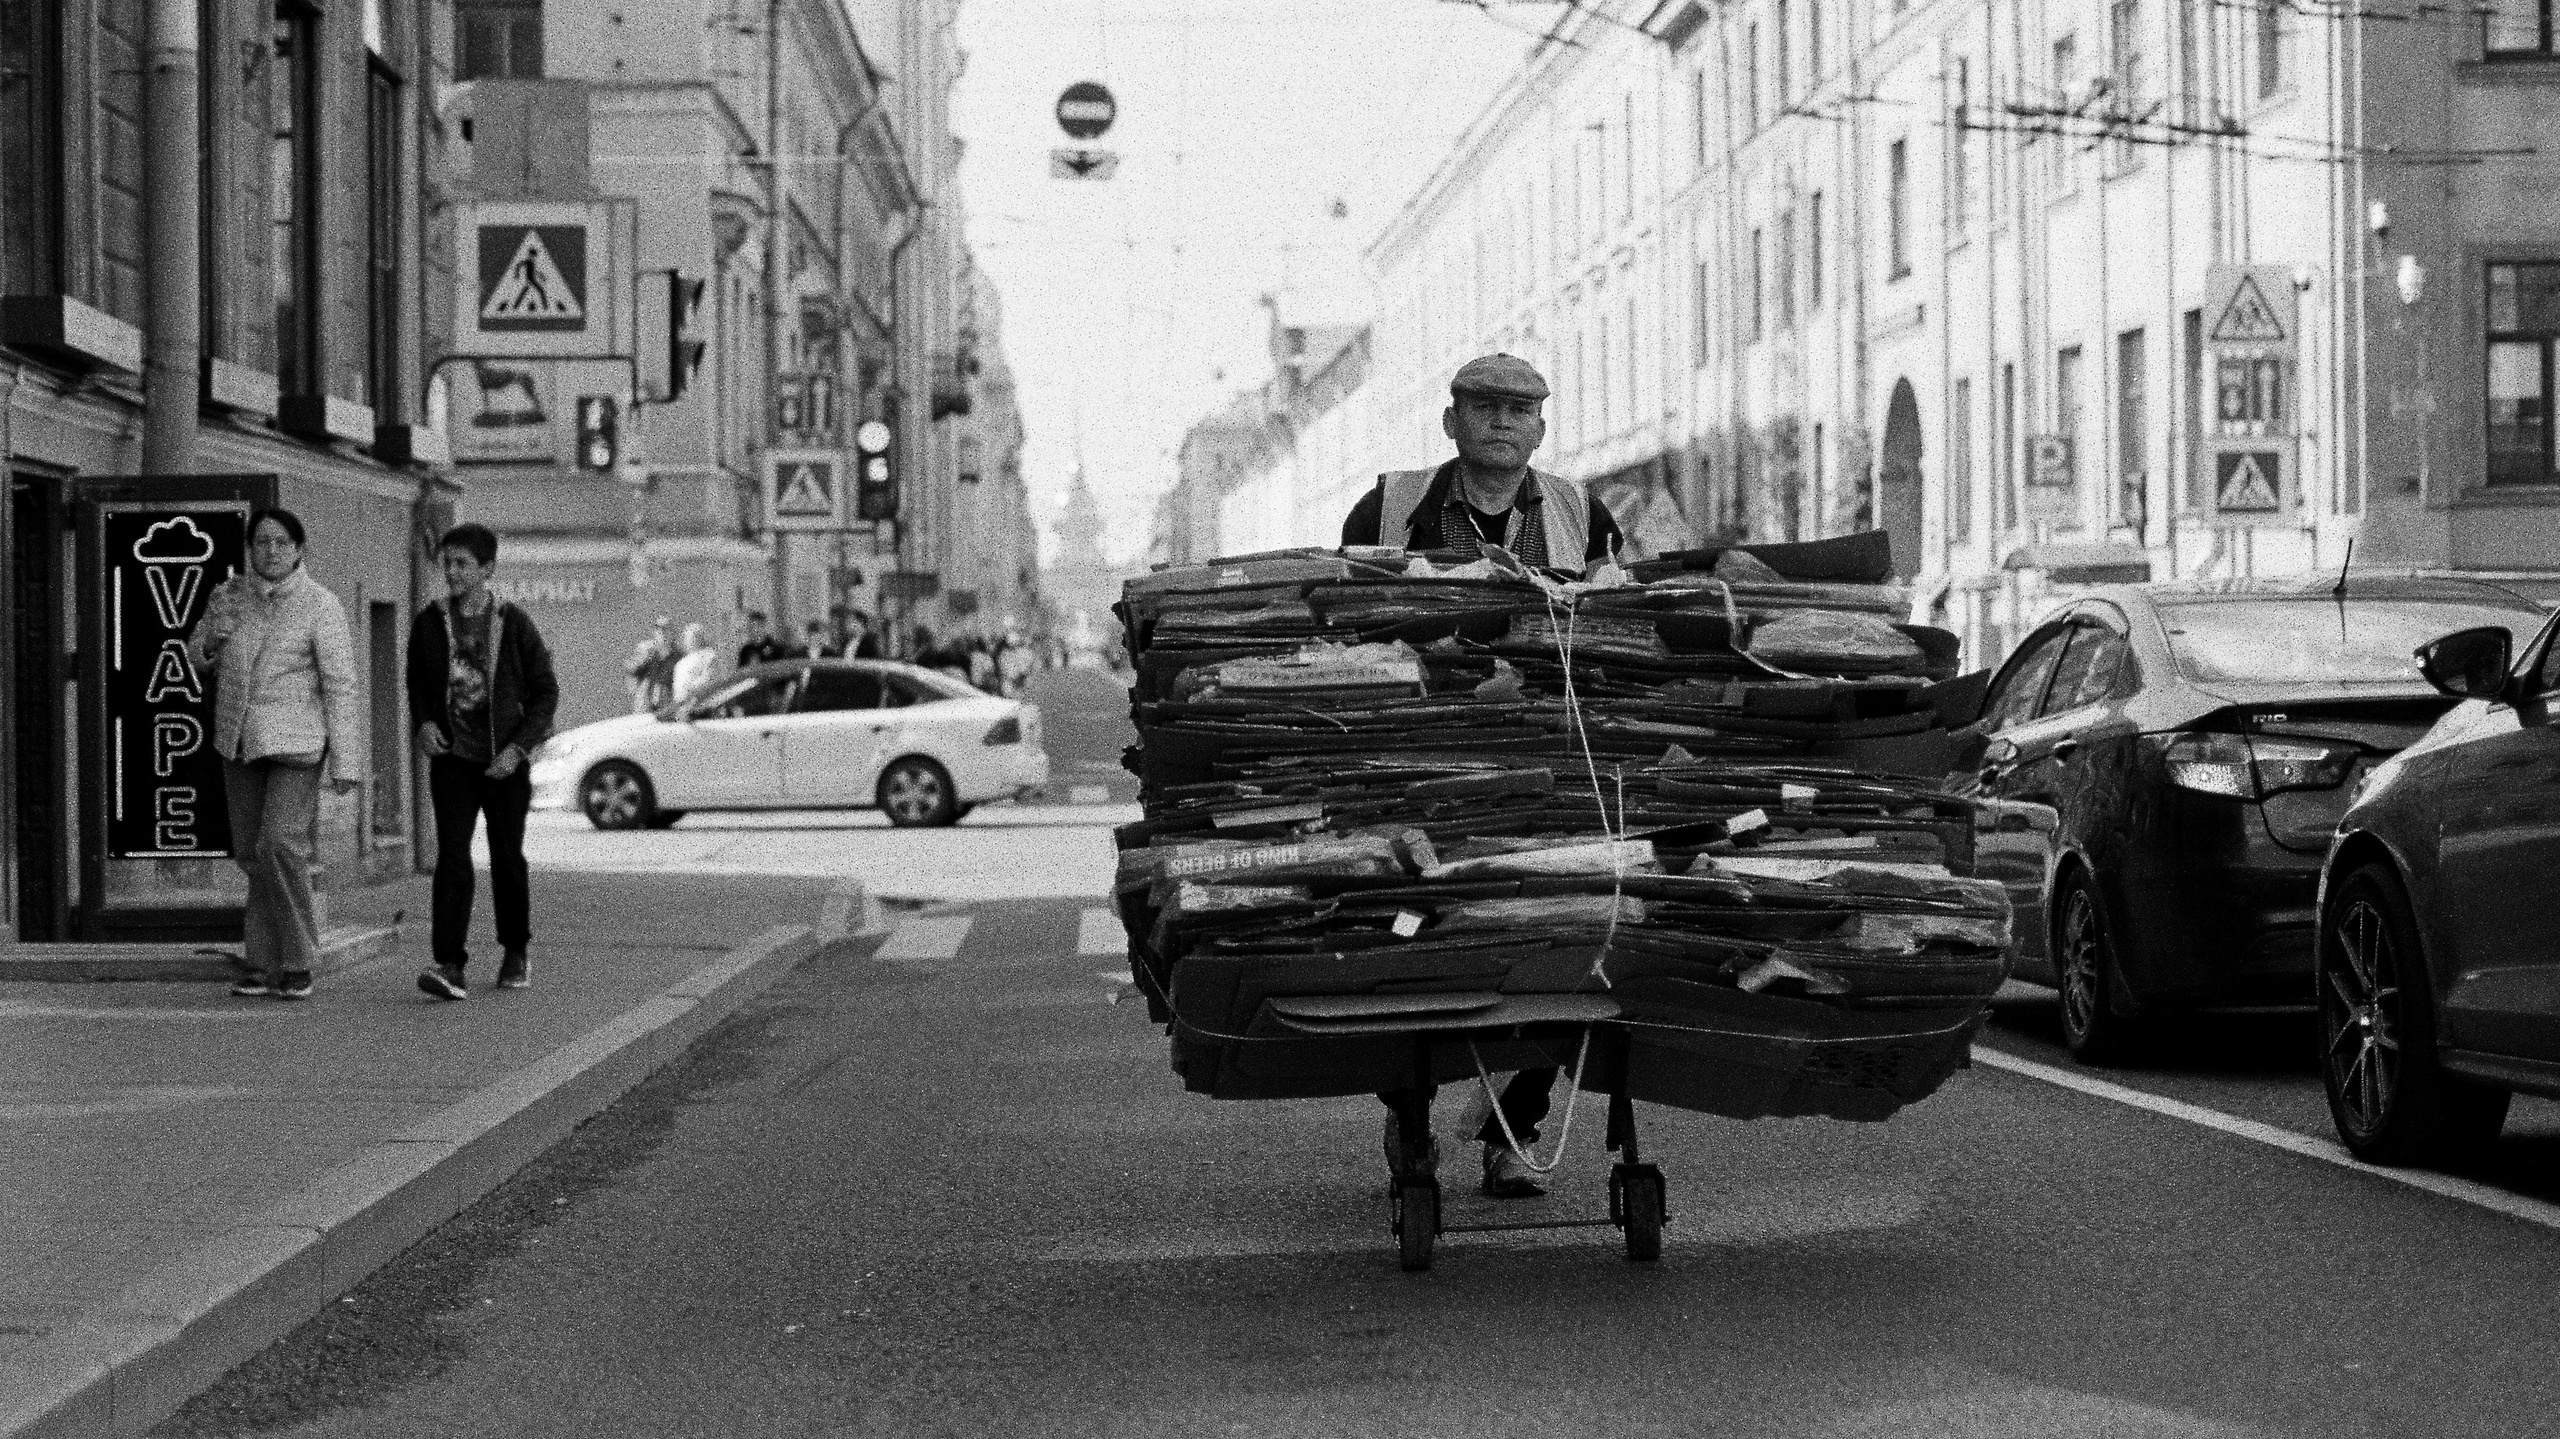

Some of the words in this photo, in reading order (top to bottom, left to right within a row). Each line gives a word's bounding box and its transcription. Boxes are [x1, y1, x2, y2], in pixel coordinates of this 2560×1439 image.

[144, 565, 204, 850] VAPE
[2252, 713, 2288, 723] RIO
[1170, 855, 1226, 876] BEERS
[1231, 851, 1251, 868] OF
[1256, 846, 1299, 866] KING
